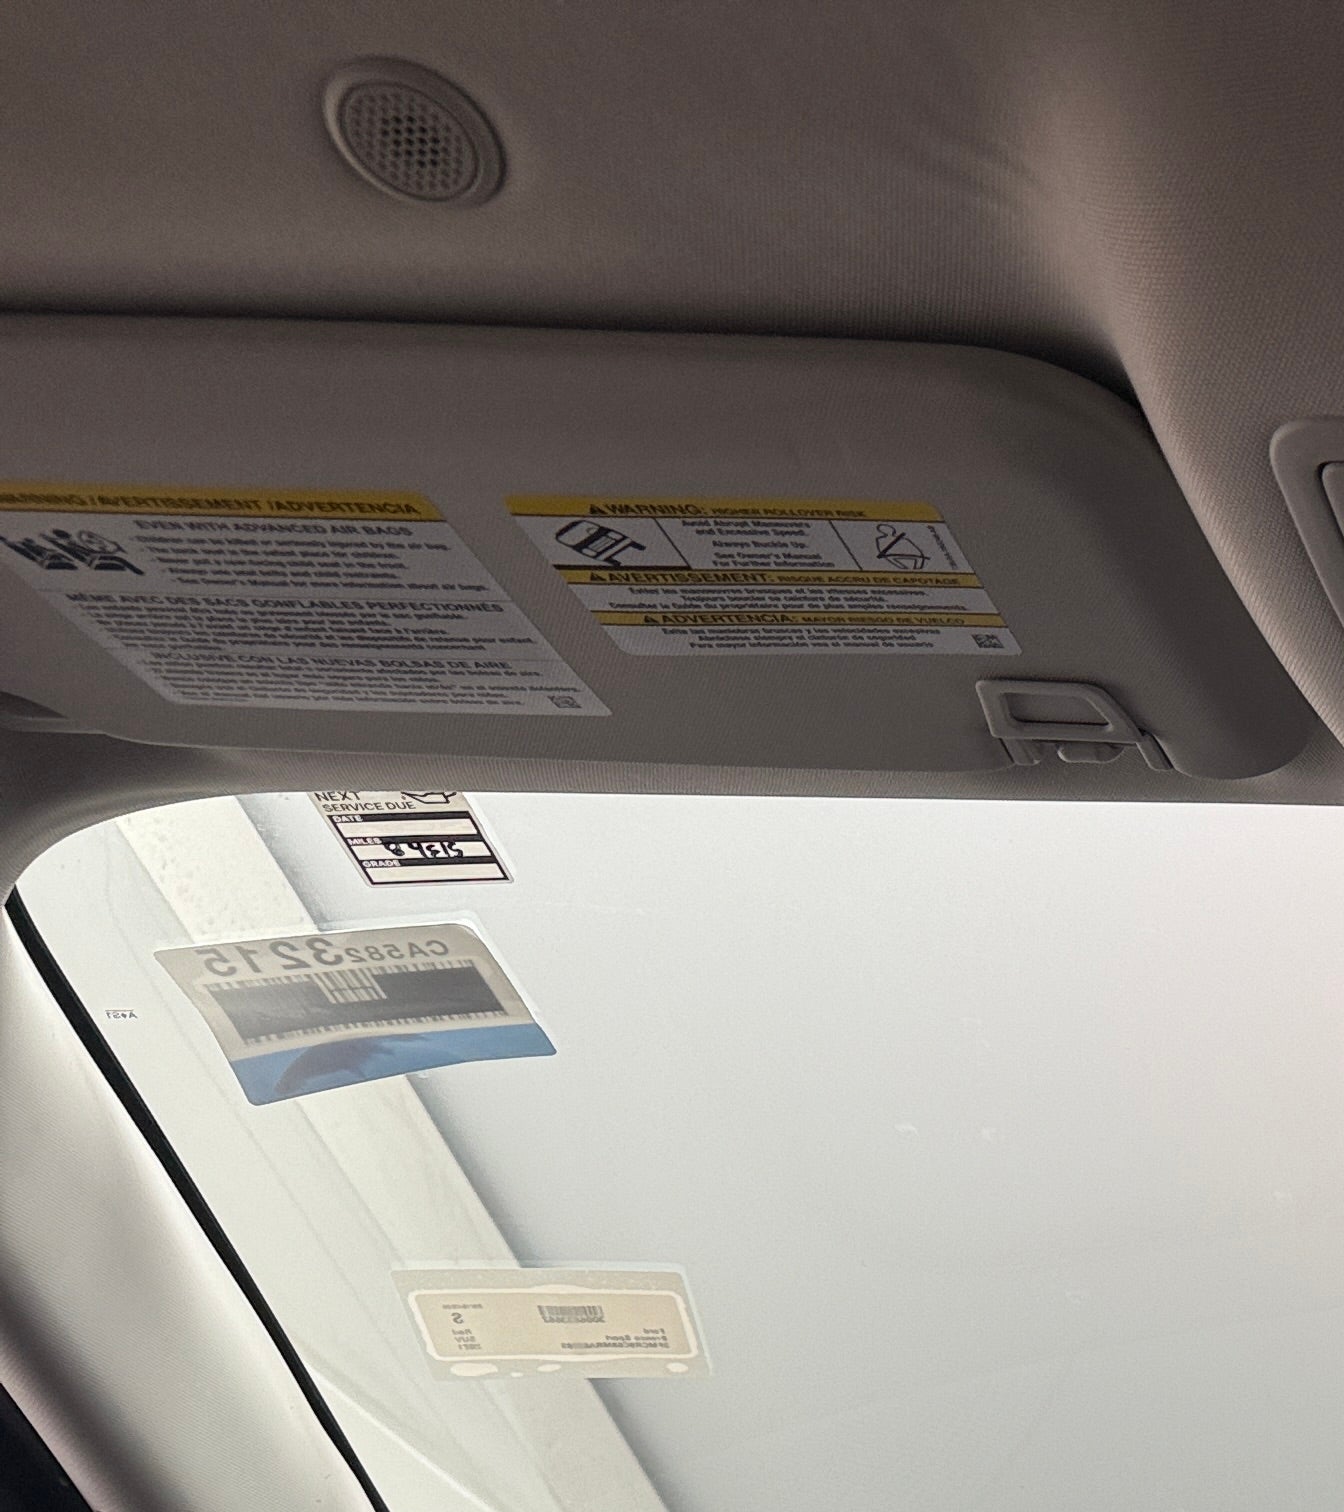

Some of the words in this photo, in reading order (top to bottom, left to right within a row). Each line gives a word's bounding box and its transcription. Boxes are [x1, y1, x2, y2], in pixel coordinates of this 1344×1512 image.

[331, 525, 361, 535] AIR
[314, 792, 361, 802] NEXT
[322, 803, 385, 813] SERVICE
[385, 801, 416, 810] DUE
